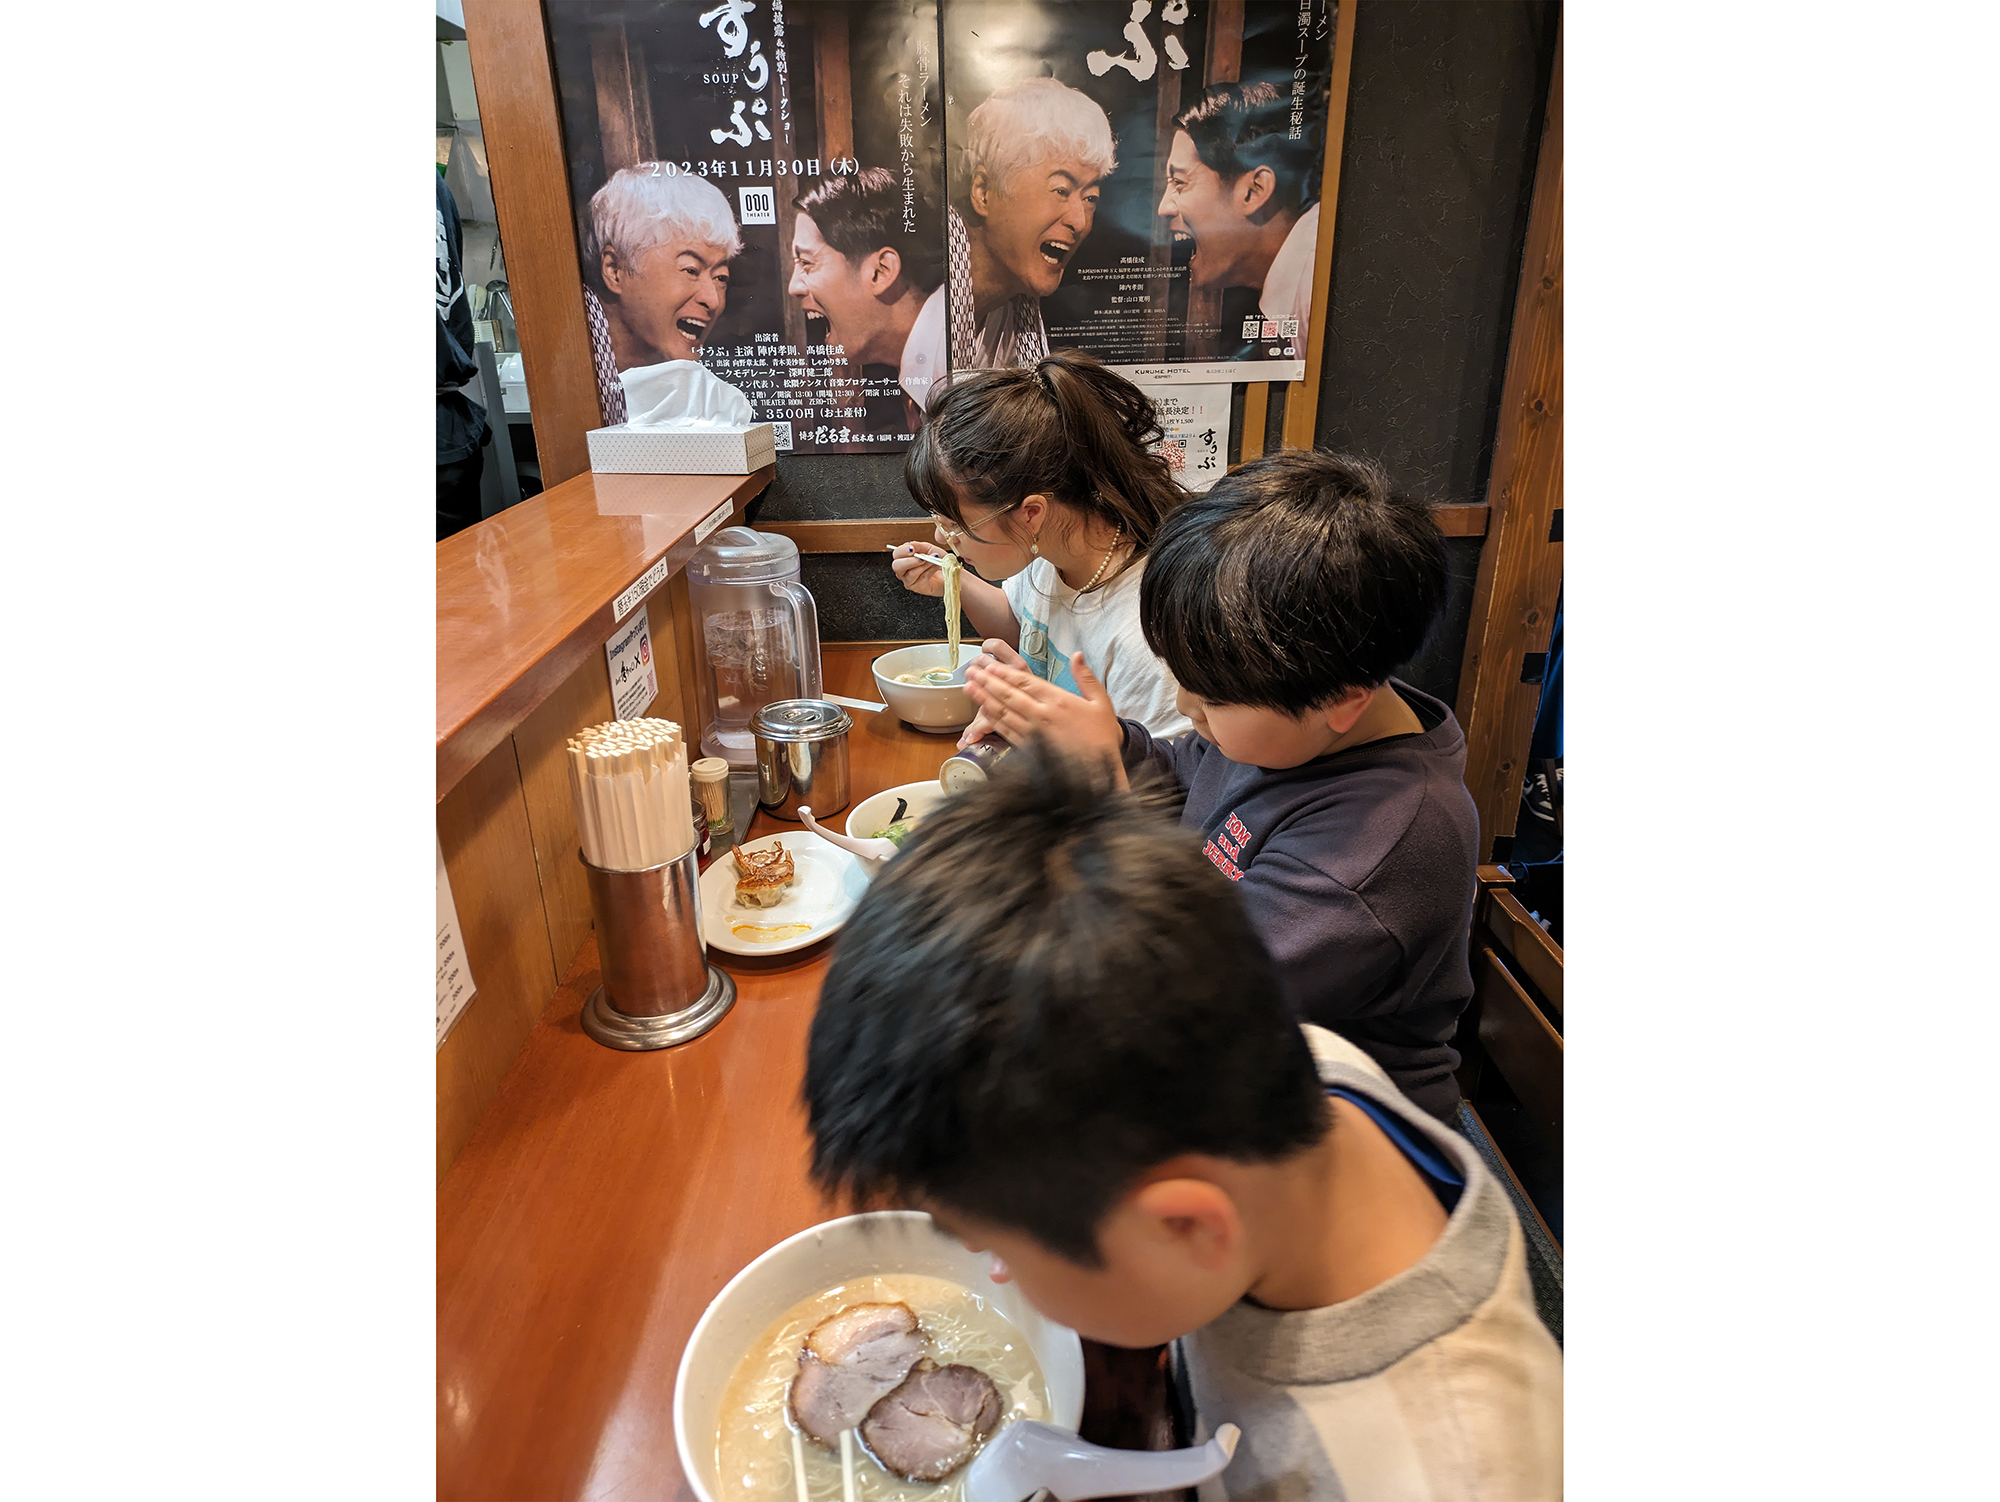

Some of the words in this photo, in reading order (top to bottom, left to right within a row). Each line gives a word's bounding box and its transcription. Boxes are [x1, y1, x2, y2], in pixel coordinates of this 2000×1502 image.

[703, 74, 739, 84] SOUP
[915, 40, 932, 127] 豚骨ラーメン
[897, 74, 917, 233] それは失敗から生まれた
[755, 333, 779, 343] 出演者
[708, 368, 785, 379] ークモデレーター
[788, 367, 833, 378] 深町健二郎
[761, 399, 785, 407] THEATER
[883, 388, 901, 397] 15:00
[1198, 428, 1218, 470] すうぷ
[1225, 811, 1252, 849] TOM
[1202, 839, 1245, 881] JERRY
[1218, 832, 1240, 863] and
